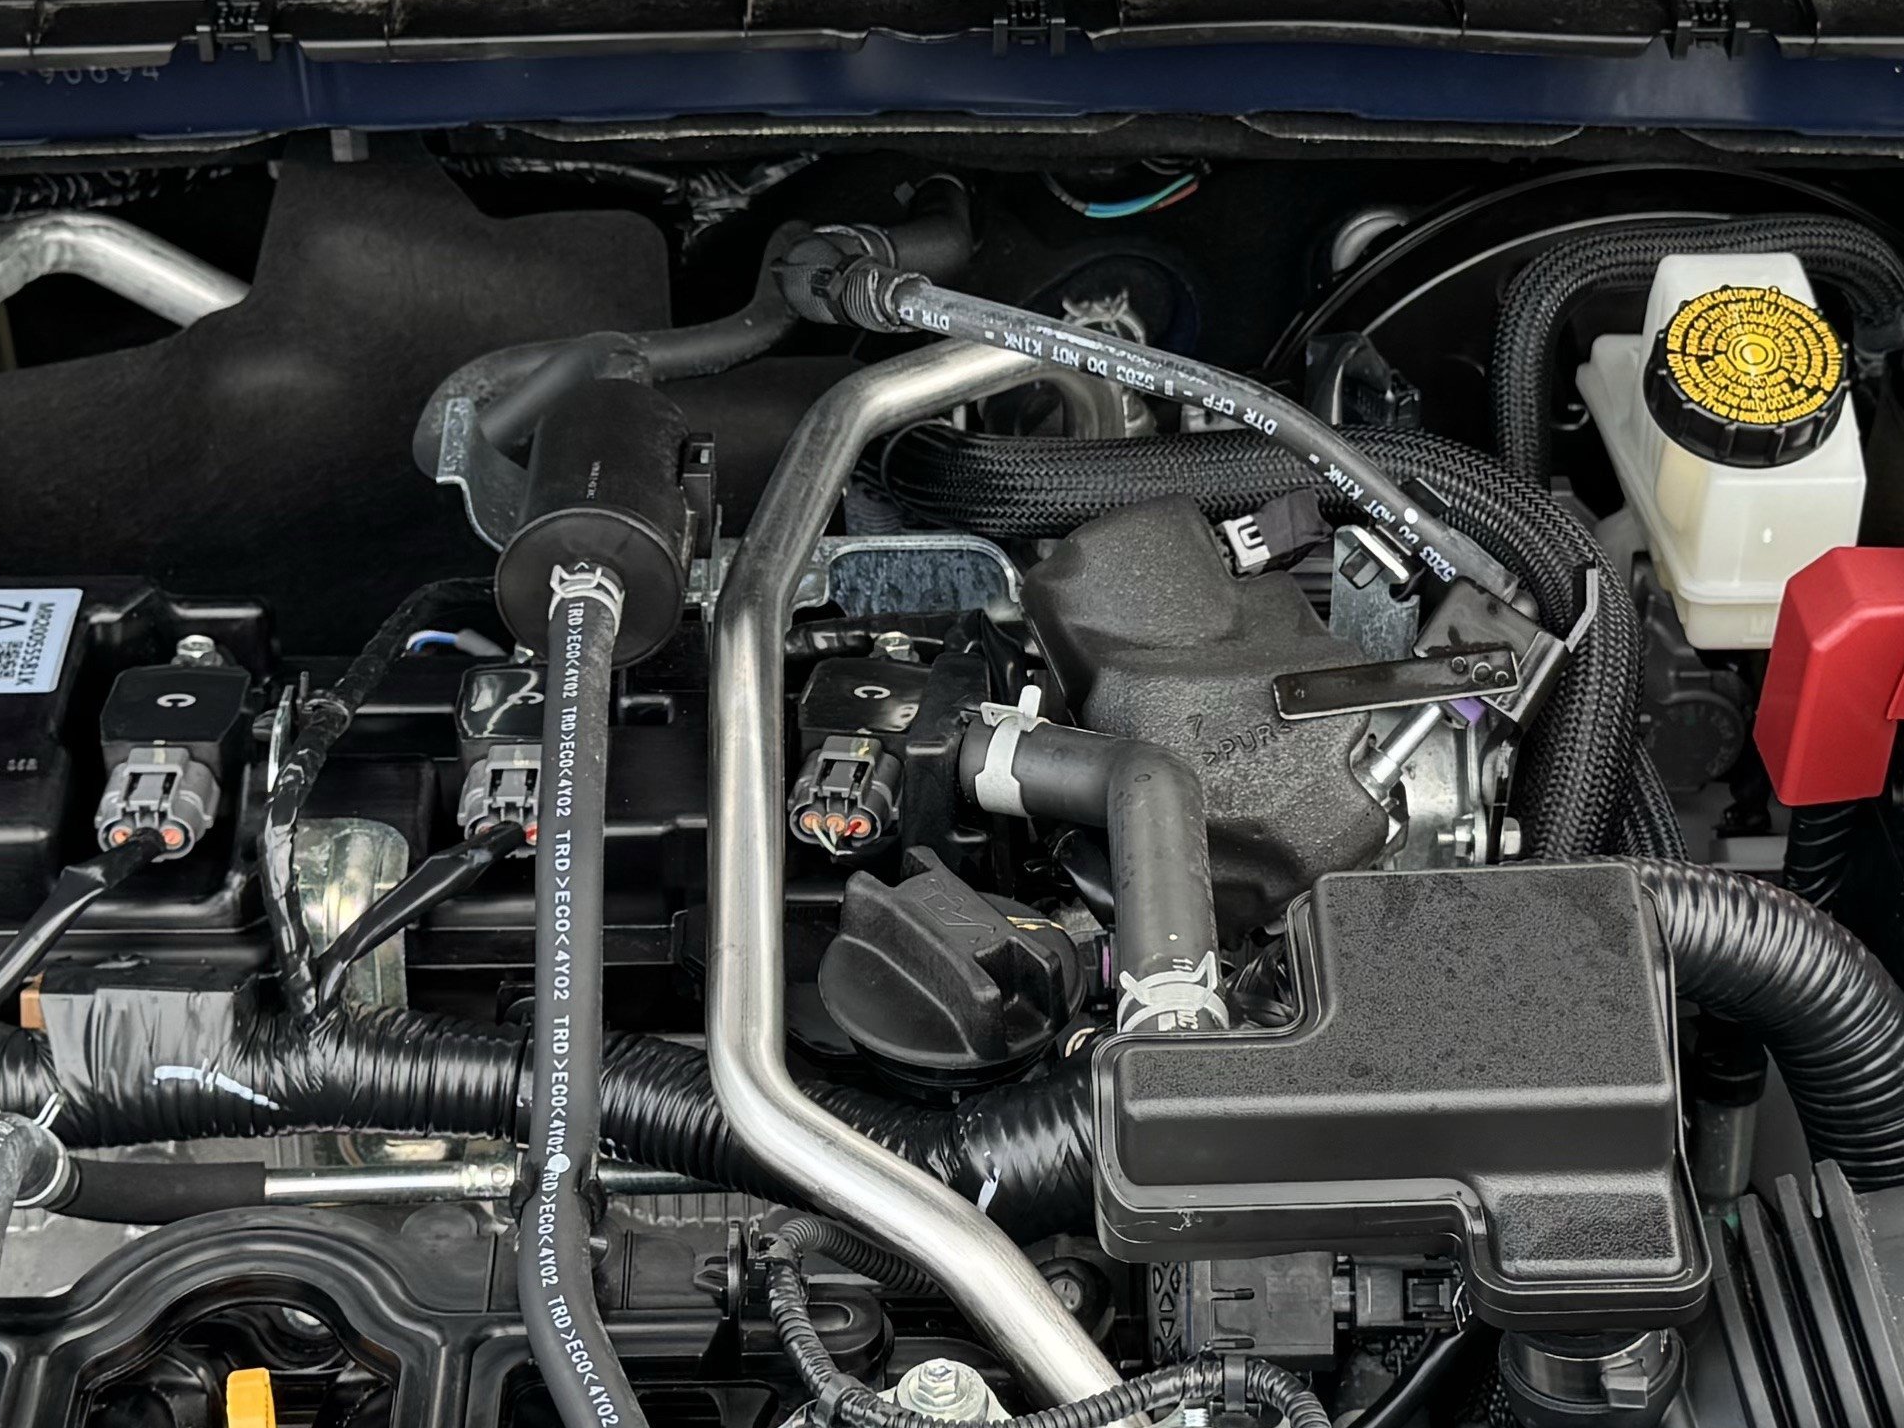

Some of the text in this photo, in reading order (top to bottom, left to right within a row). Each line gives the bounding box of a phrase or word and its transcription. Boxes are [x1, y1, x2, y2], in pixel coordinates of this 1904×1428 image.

[922, 310, 949, 330] DTR
[1004, 331, 1042, 356] KINK
[1051, 345, 1080, 367] NOT
[1087, 362, 1108, 377] DO
[1202, 394, 1235, 414] CFP
[1243, 407, 1278, 436] DTR
[1324, 464, 1364, 501] KINK
